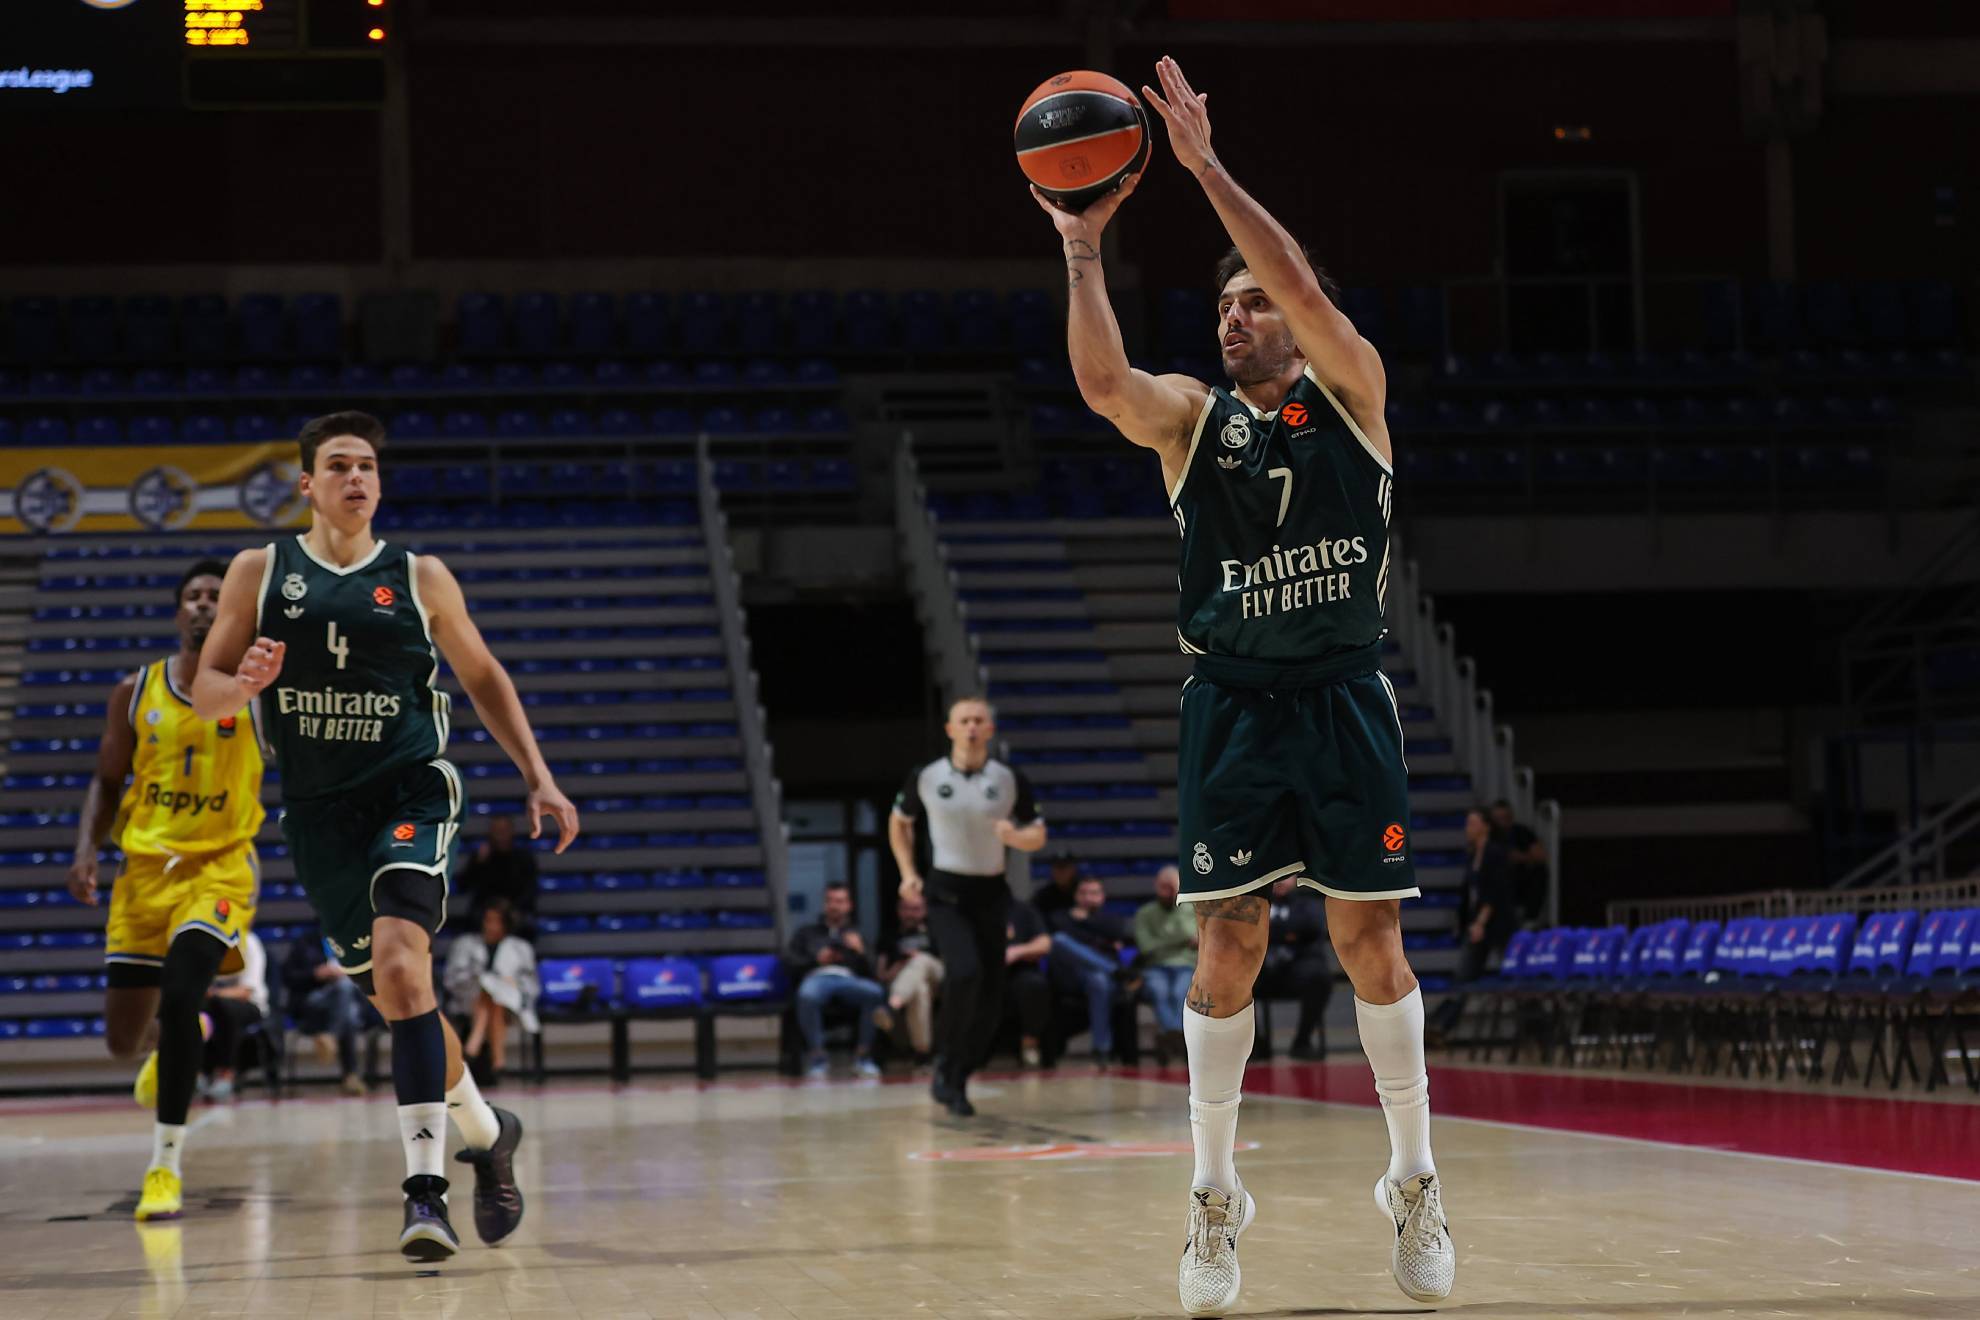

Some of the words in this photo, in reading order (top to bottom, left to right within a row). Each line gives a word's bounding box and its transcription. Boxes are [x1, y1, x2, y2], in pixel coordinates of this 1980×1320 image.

[1291, 427, 1317, 439] ETIHAD
[1268, 467, 1293, 528] 7
[1220, 536, 1368, 593] Emirates
[1242, 588, 1275, 619] FLY
[1282, 572, 1351, 612] BETTER
[327, 621, 350, 669] 4
[277, 687, 400, 717] Emirates
[299, 716, 321, 738] FLY
[324, 718, 384, 742] BETTER
[184, 745, 194, 777] 1
[144, 783, 228, 816] Rapyd
[1383, 856, 1405, 864] ETIHAD
